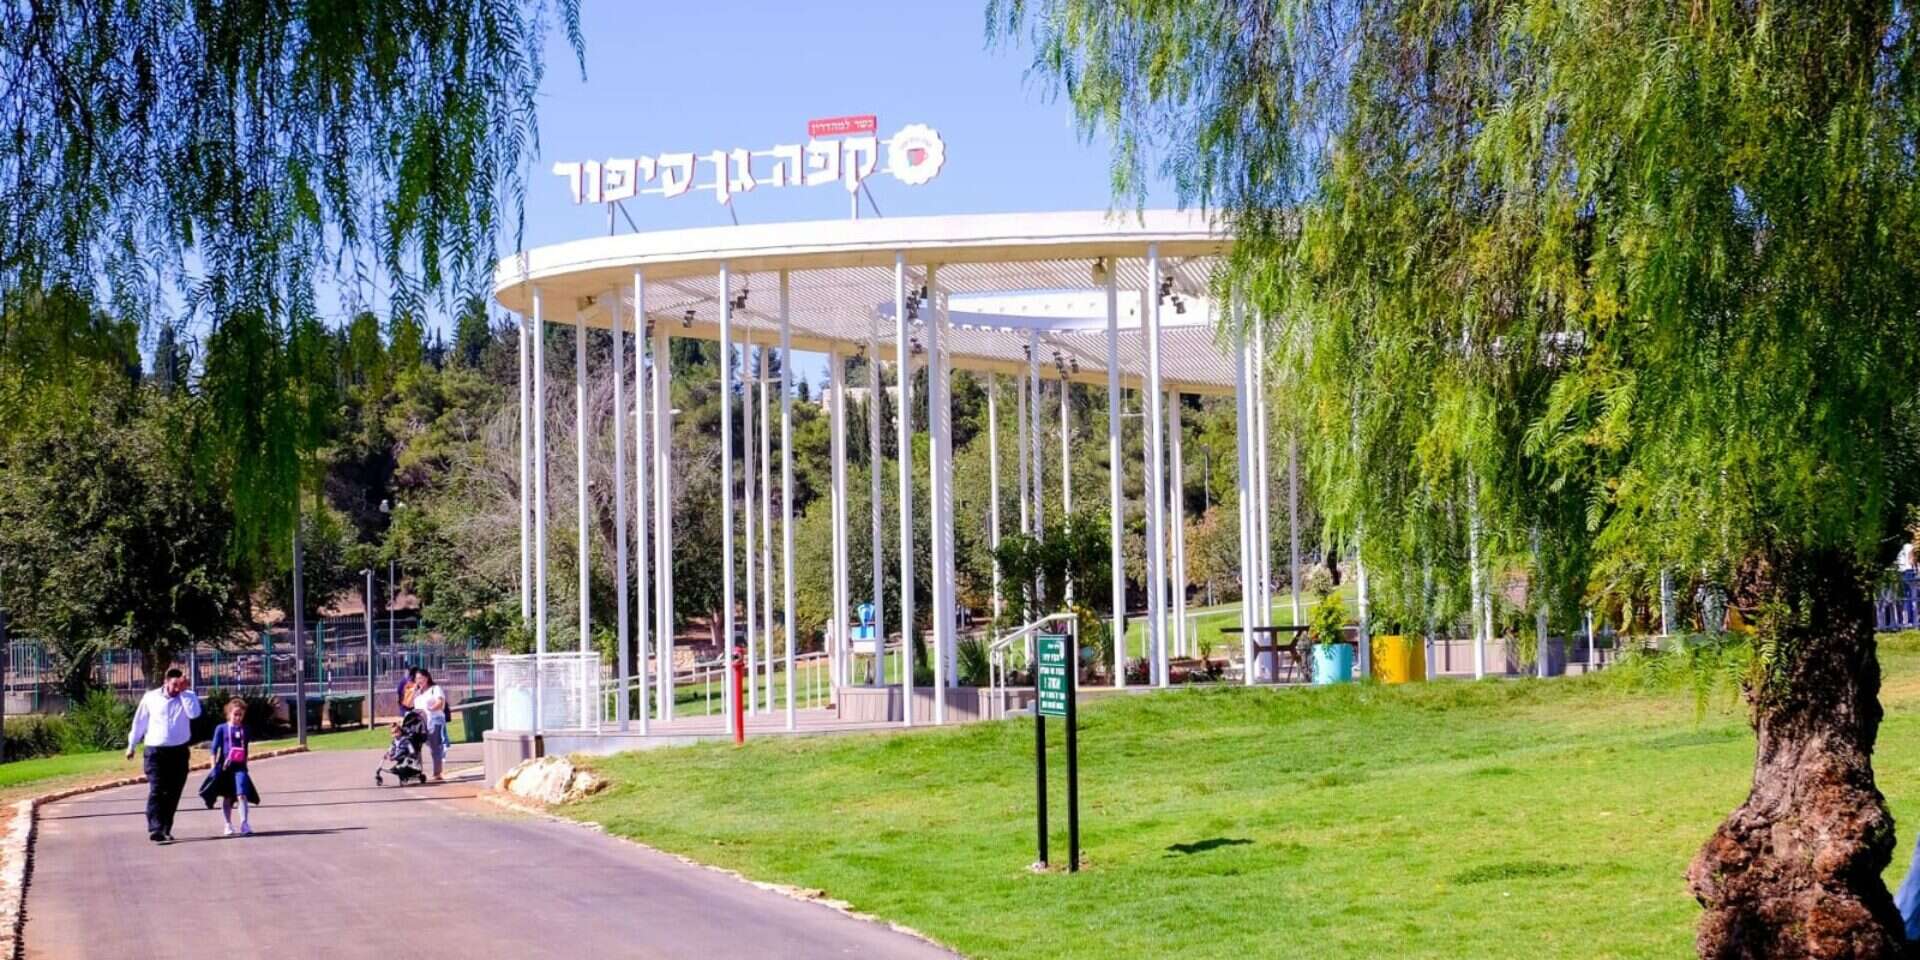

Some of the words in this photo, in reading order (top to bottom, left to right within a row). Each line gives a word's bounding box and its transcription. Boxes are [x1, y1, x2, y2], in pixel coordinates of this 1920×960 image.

[854, 120, 873, 129] כשר
[552, 152, 697, 205] סיפור
[712, 148, 758, 205] גן
[772, 136, 878, 194] קפה
